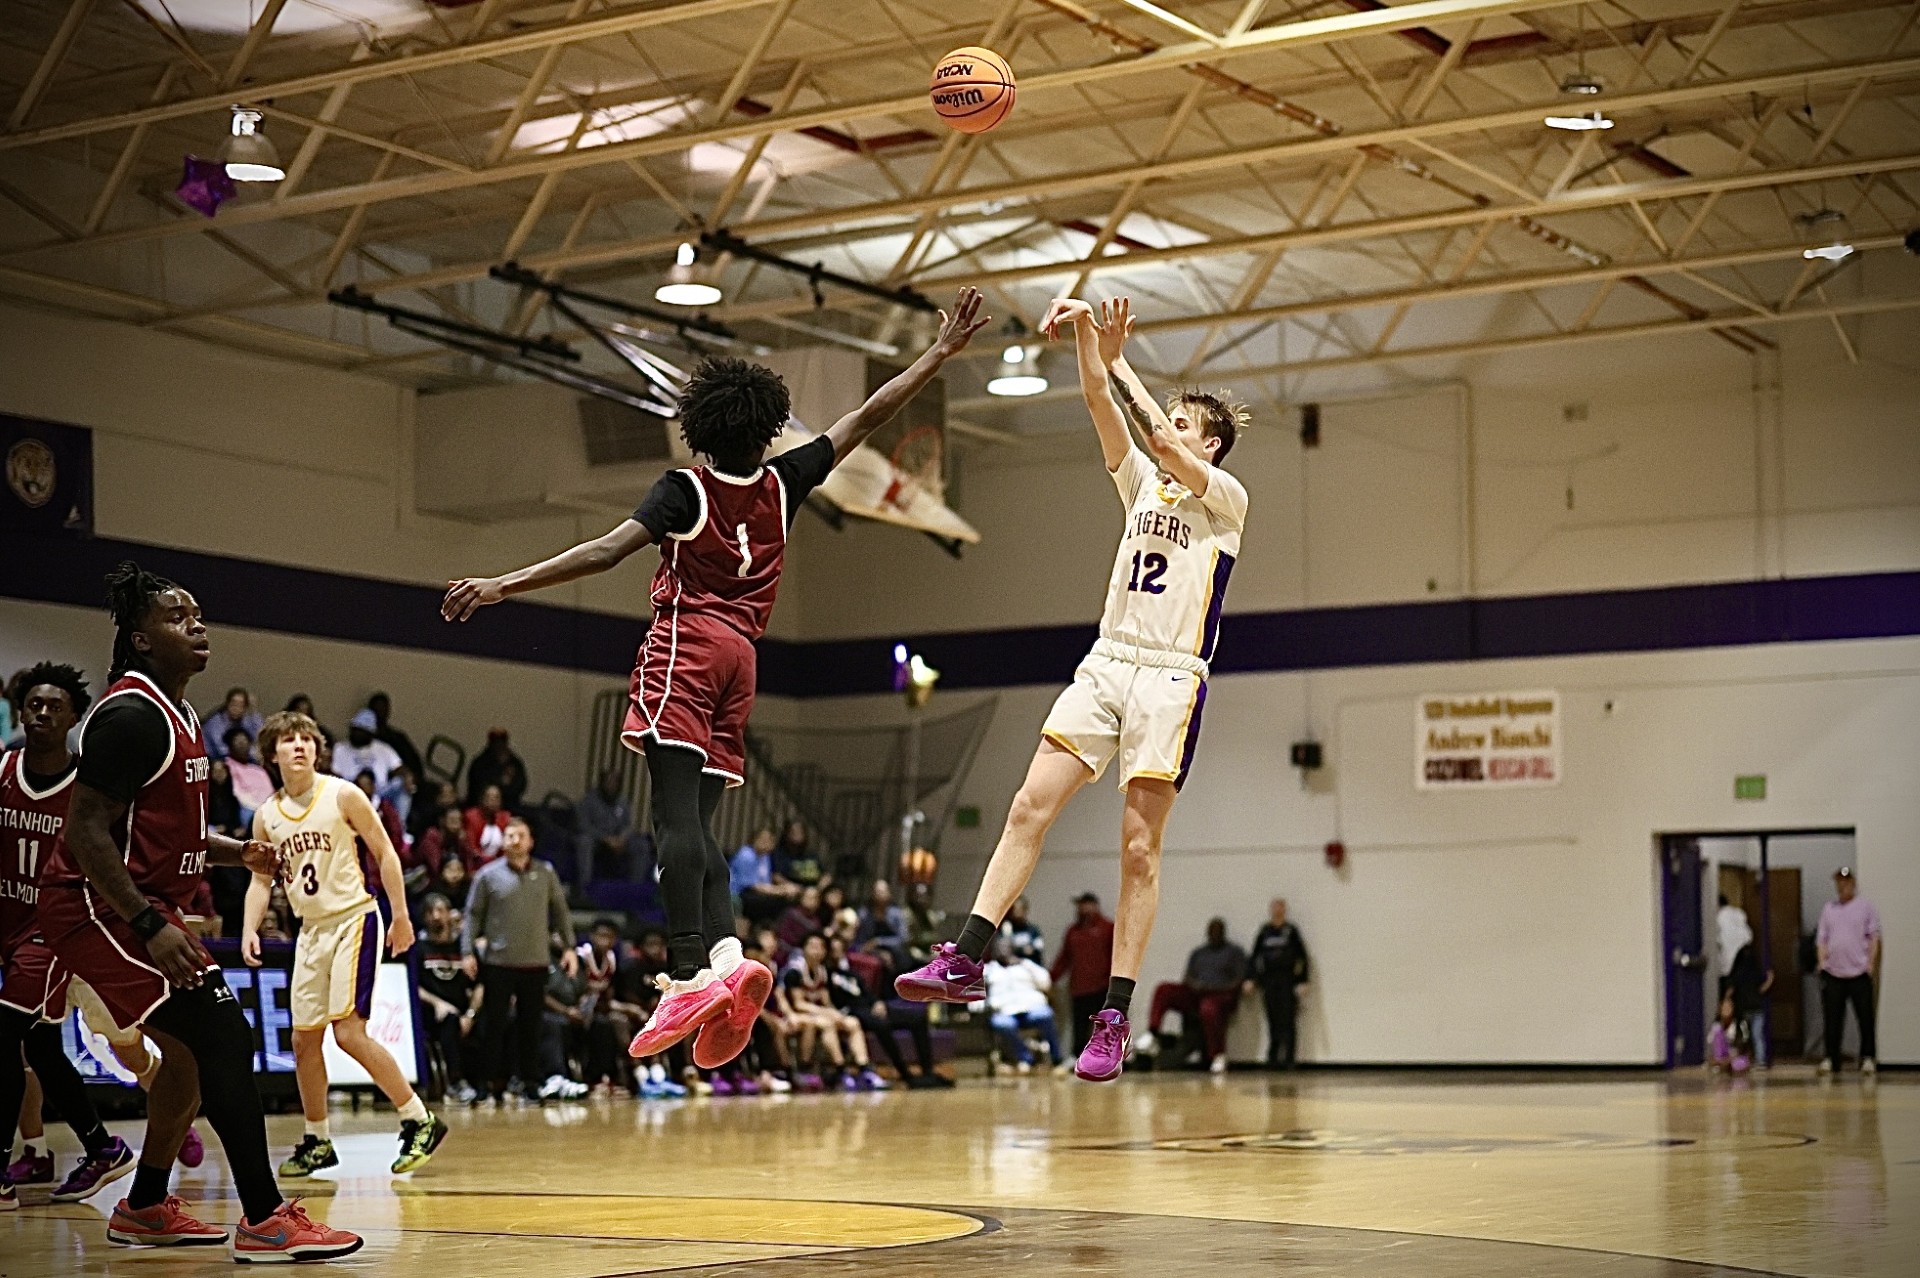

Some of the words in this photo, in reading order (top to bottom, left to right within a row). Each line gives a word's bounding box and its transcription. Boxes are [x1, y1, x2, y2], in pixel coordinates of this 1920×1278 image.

[936, 64, 973, 80] NCAA
[933, 88, 984, 108] Wilson
[1127, 510, 1191, 550] IGERS
[736, 523, 752, 577] 1
[1127, 550, 1168, 595] 12
[0, 807, 63, 835] TANHOP
[18, 838, 39, 878] 11
[301, 863, 319, 896] 3
